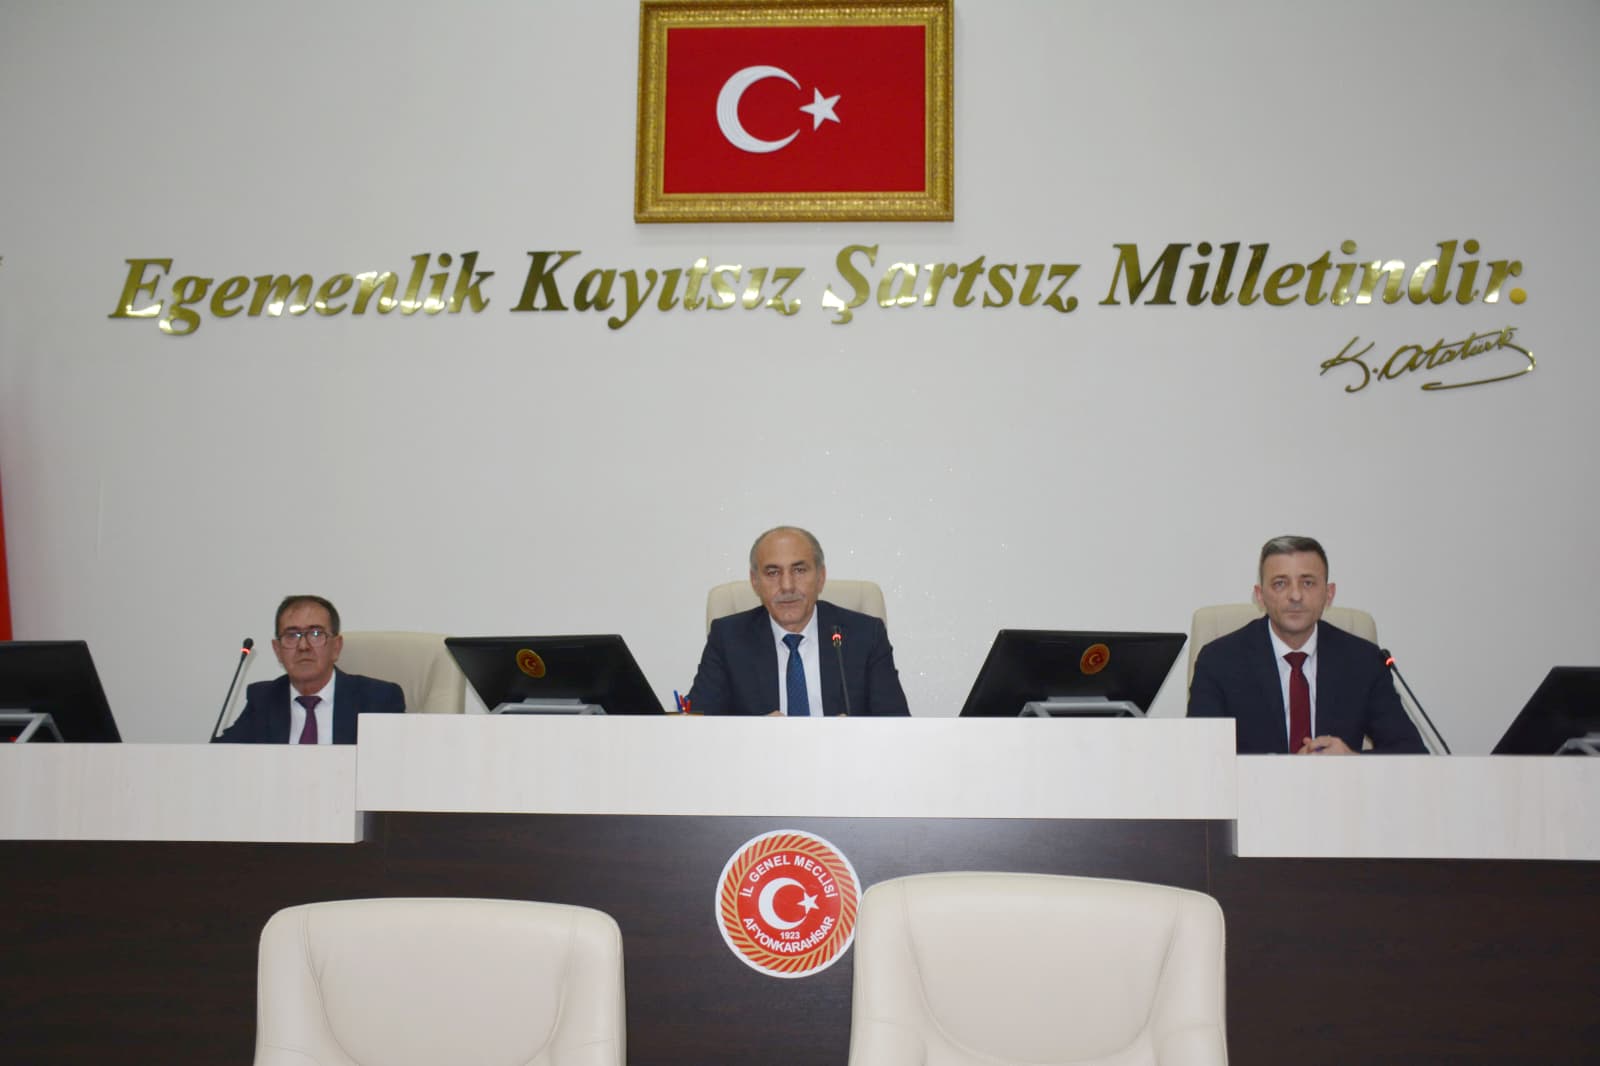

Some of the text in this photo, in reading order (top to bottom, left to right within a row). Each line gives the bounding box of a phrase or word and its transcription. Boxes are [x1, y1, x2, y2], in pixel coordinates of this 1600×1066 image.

[108, 239, 1527, 336] Egemenlik Kayıtsız Şartsız Milletindir.
[739, 855, 839, 898] İL GENEL MECLİSİ
[743, 916, 836, 953] AFYONKARAHİSAR
[780, 931, 801, 940] 1923
